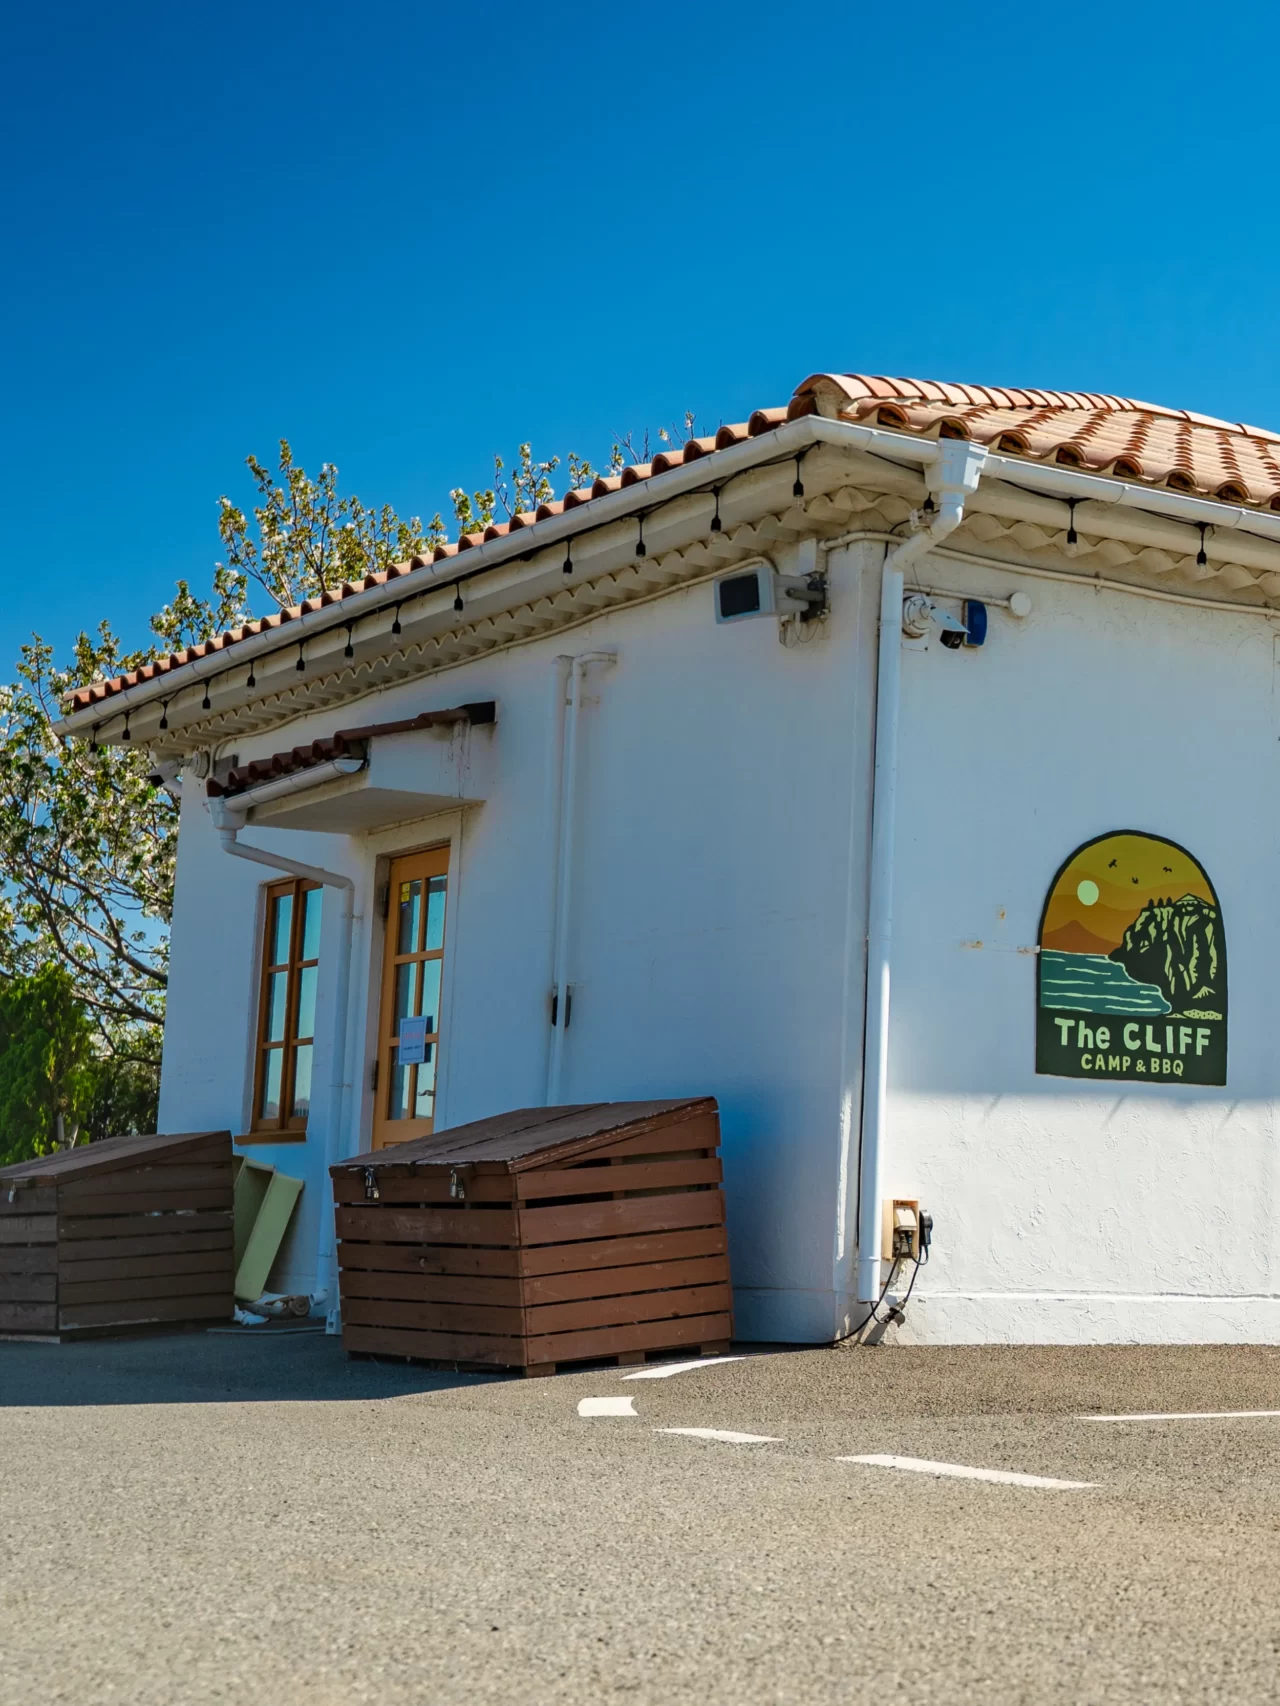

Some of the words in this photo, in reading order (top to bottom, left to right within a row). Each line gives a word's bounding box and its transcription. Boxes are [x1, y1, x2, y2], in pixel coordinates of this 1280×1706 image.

[1054, 1017, 1111, 1050] The
[1123, 1022, 1211, 1056] CLIFF
[1080, 1053, 1131, 1072] CAMP
[1135, 1059, 1147, 1073] &
[1150, 1057, 1184, 1077] BBQ
